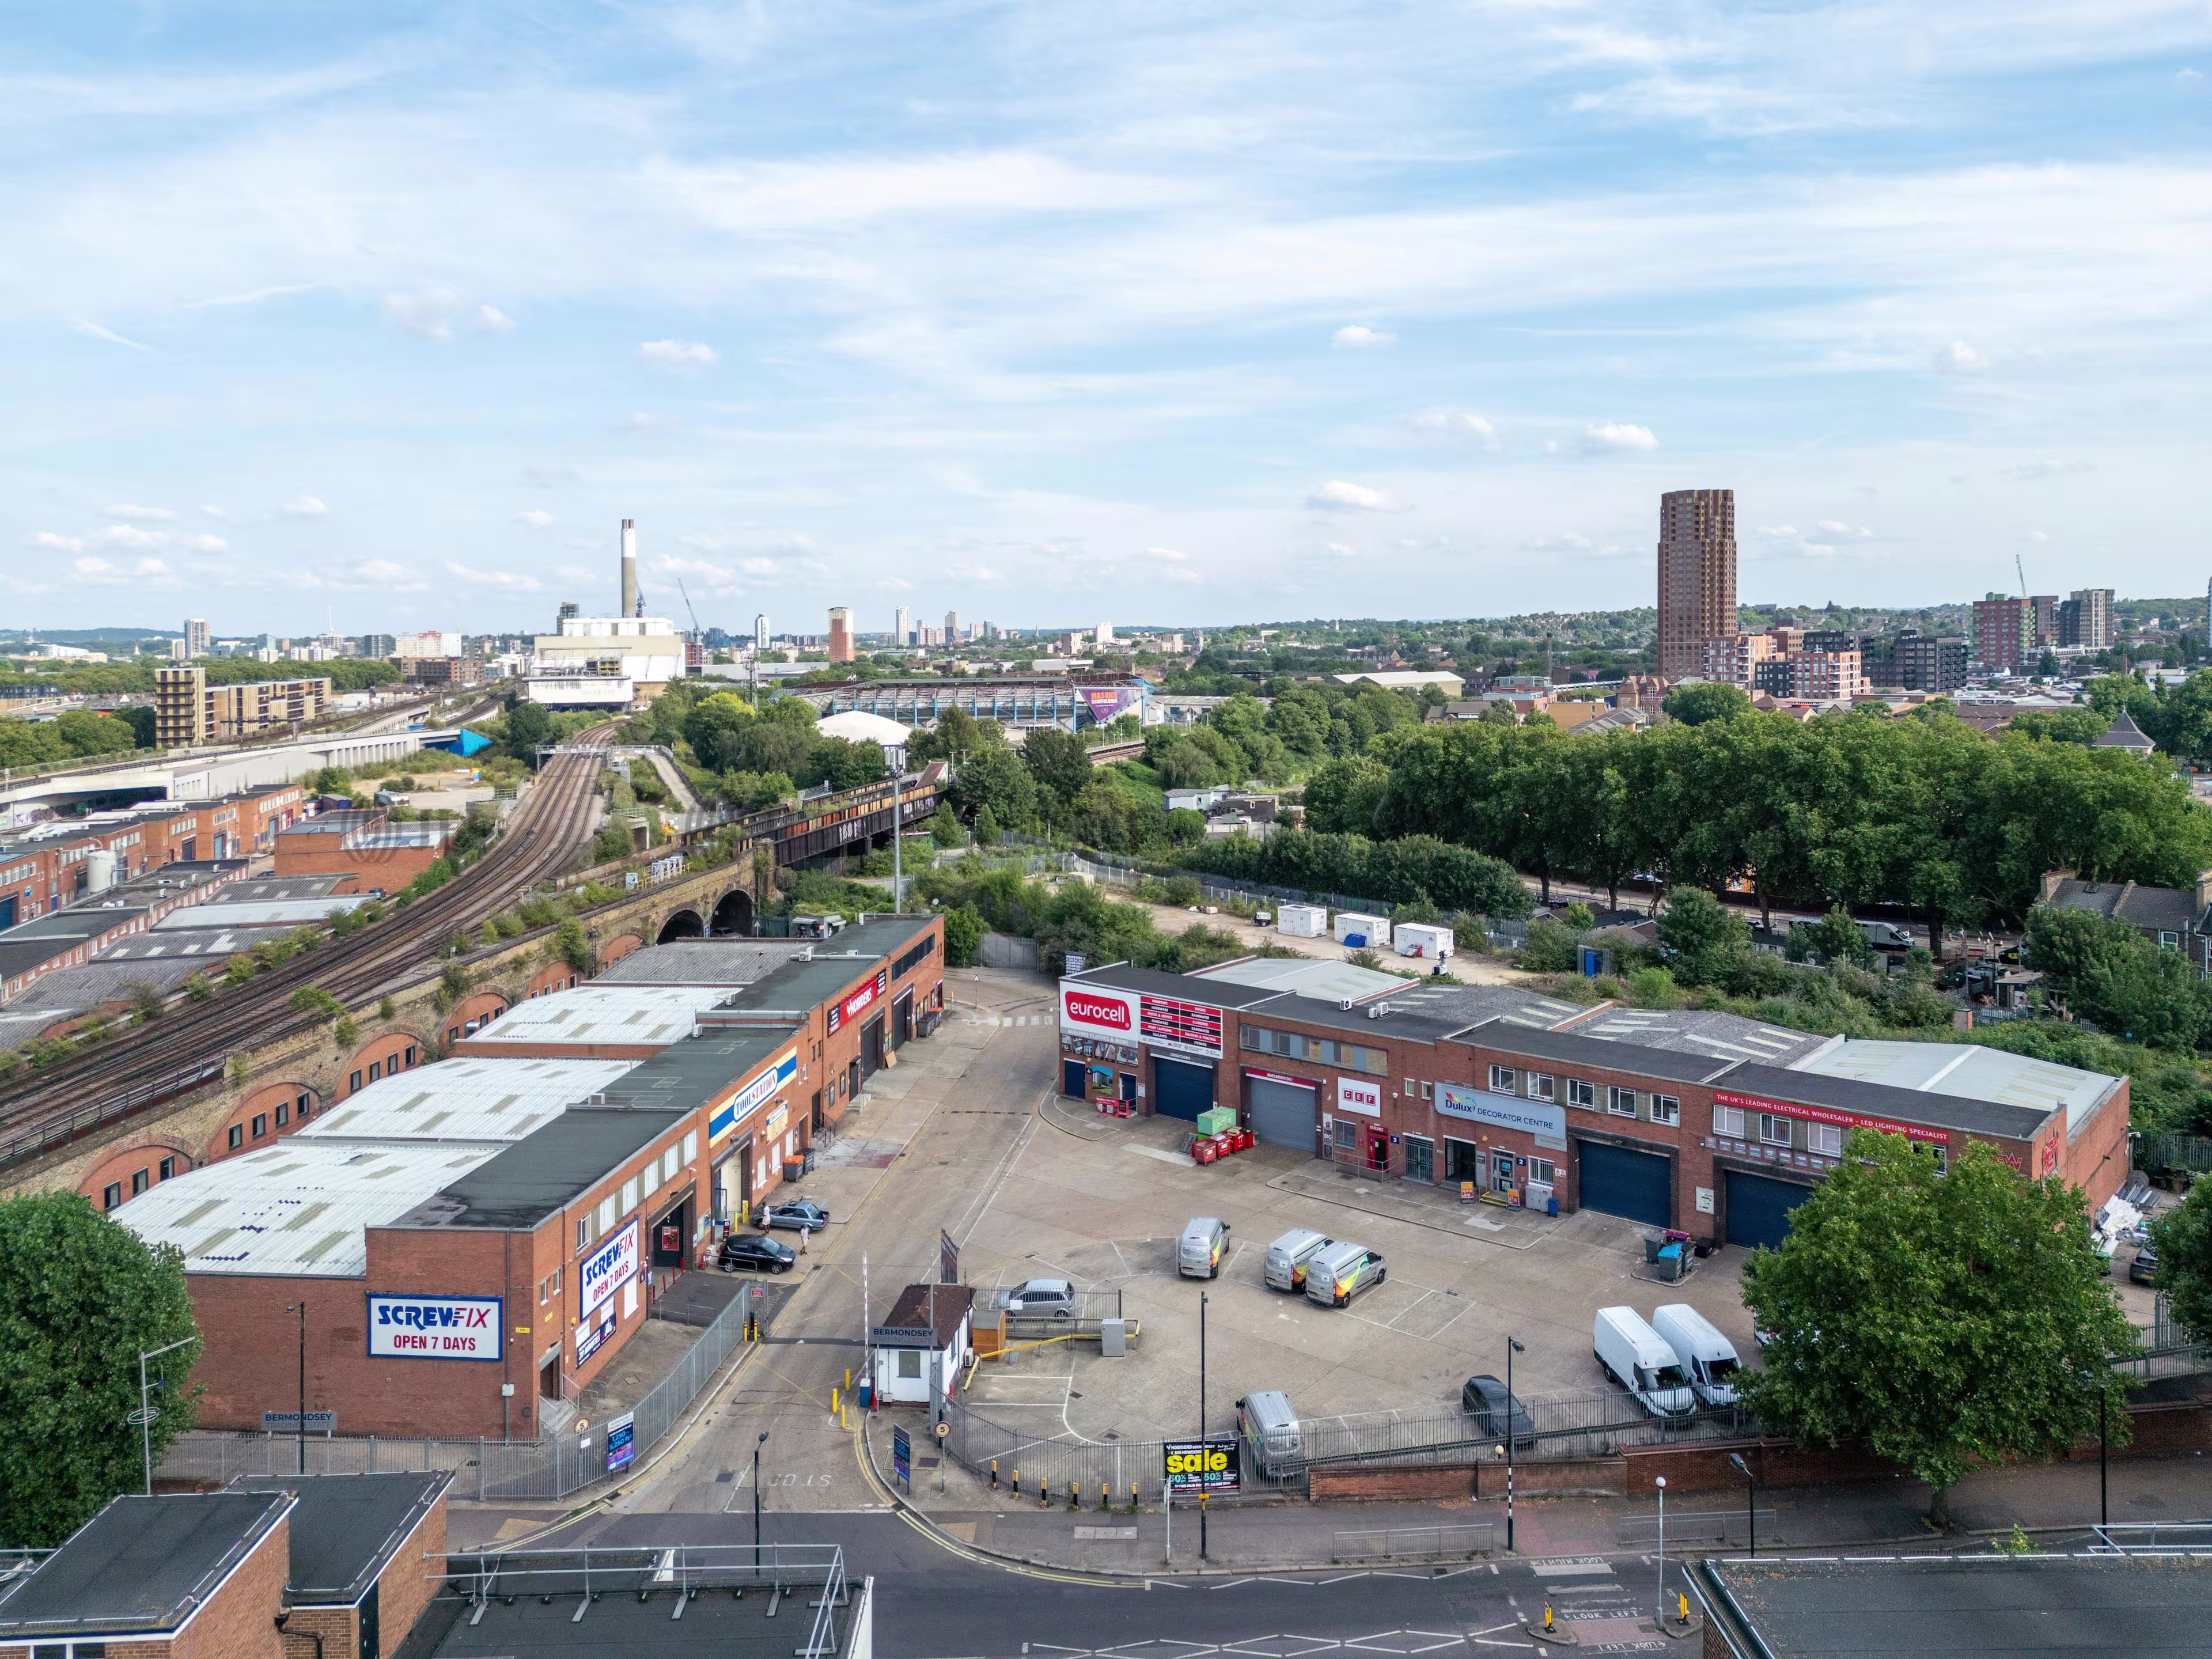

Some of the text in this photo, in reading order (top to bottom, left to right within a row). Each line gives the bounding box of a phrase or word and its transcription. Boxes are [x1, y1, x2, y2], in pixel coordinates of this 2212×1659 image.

[1091, 691, 1116, 699] MASONS
[851, 987, 872, 1015] HOWDENS
[1070, 1001, 1124, 1023] eurocell
[1068, 1029, 1089, 1037] BUILDING
[1090, 1033, 1109, 1041] PLASTICS
[736, 1073, 775, 1115] TOOLSTATION
[1344, 1090, 1373, 1104] CEF
[1446, 1099, 1554, 1129] Dulux DECORATOR CENTRE
[1730, 1096, 1744, 1104] UK'S
[1745, 1099, 1772, 1109] LEADING
[1774, 1105, 1810, 1116] ELECTRICAL
[1811, 1112, 1854, 1123] WHOLESALER
[1876, 1122, 1907, 1133] LIGHTING
[1909, 1128, 1947, 1139] SPECIALIST
[586, 1229, 634, 1286] SCREWFIX
[593, 1260, 628, 1302] OPEN 7 DAYS
[378, 1305, 491, 1331] SCREWFIX
[394, 1335, 476, 1351] OPEN 7 DAYS
[874, 1328, 933, 1336] BERMONDSEY
[1167, 1449, 1227, 1472] sale
[1171, 1475, 1186, 1483] 50%
[1205, 1472, 1221, 1481] 50%
[1599, 1642, 1661, 1651] LOOK LEFT
